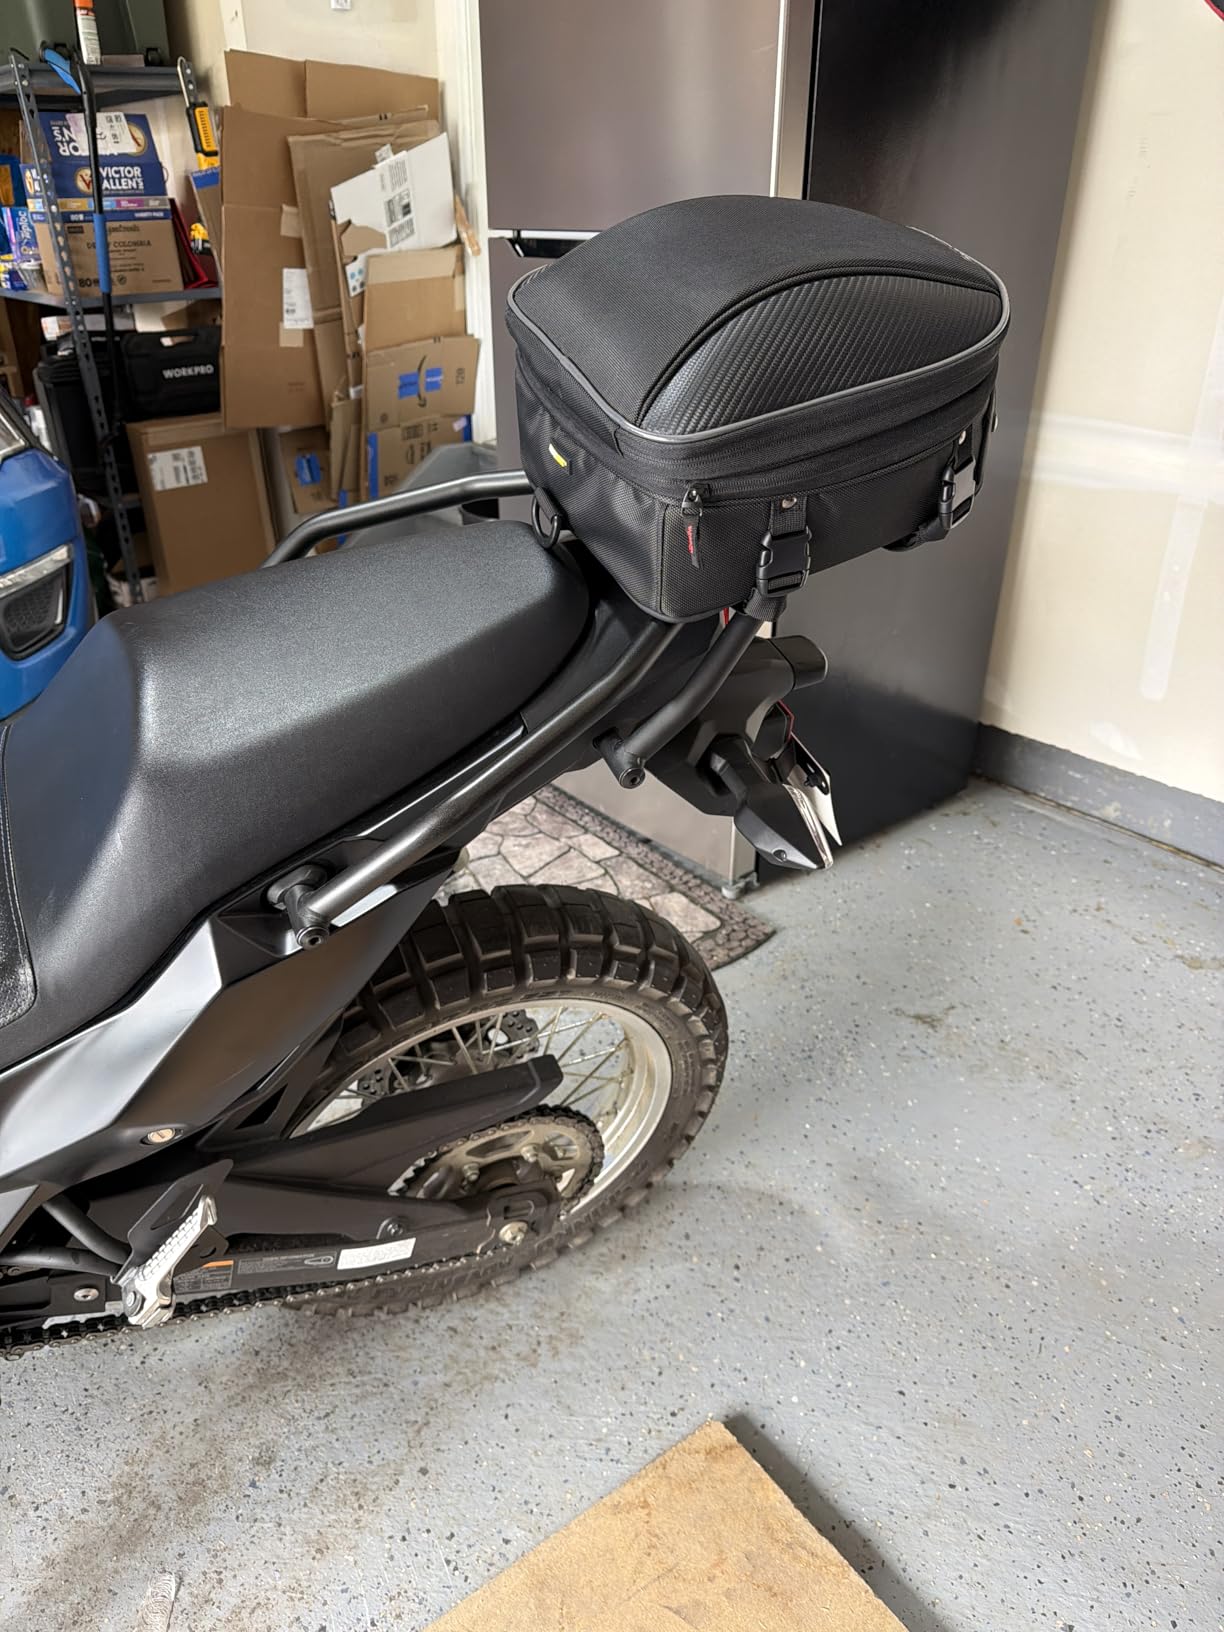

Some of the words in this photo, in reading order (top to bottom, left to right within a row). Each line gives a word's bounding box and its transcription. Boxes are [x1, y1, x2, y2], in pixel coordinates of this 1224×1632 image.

[99, 166, 141, 178] VICTOR
[102, 177, 144, 190] ALLEN'S
[162, 364, 214, 379] WORKPRO
